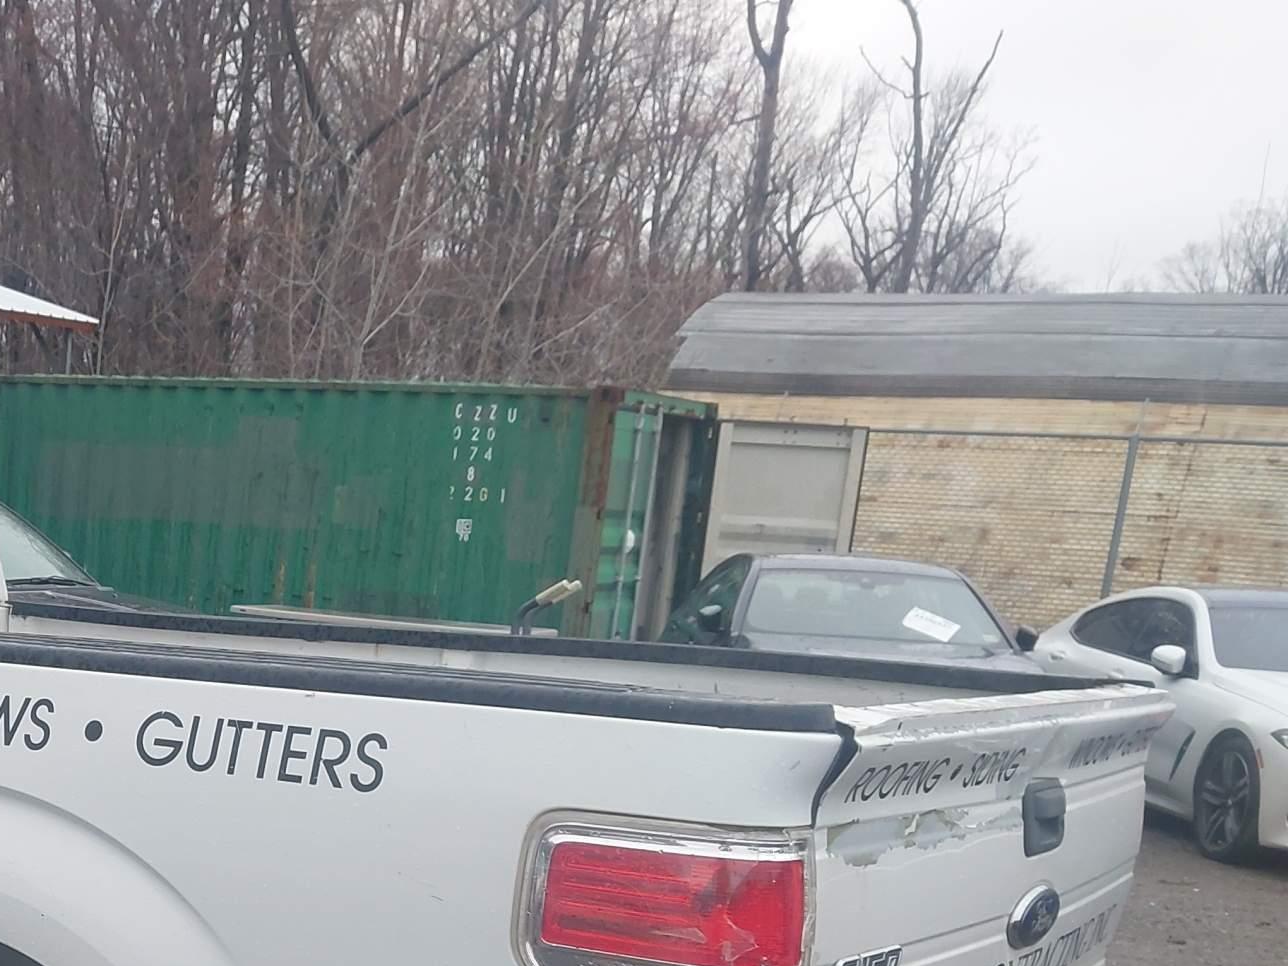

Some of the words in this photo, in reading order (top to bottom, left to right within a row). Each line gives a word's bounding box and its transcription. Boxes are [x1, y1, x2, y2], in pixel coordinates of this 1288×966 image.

[454, 426, 496, 441] 020
[453, 446, 493, 461] 174
[467, 465, 475, 481] 8
[136, 711, 388, 793] GUTTERS
[844, 757, 952, 804] ROOFING
[962, 747, 1028, 789] SIDING
